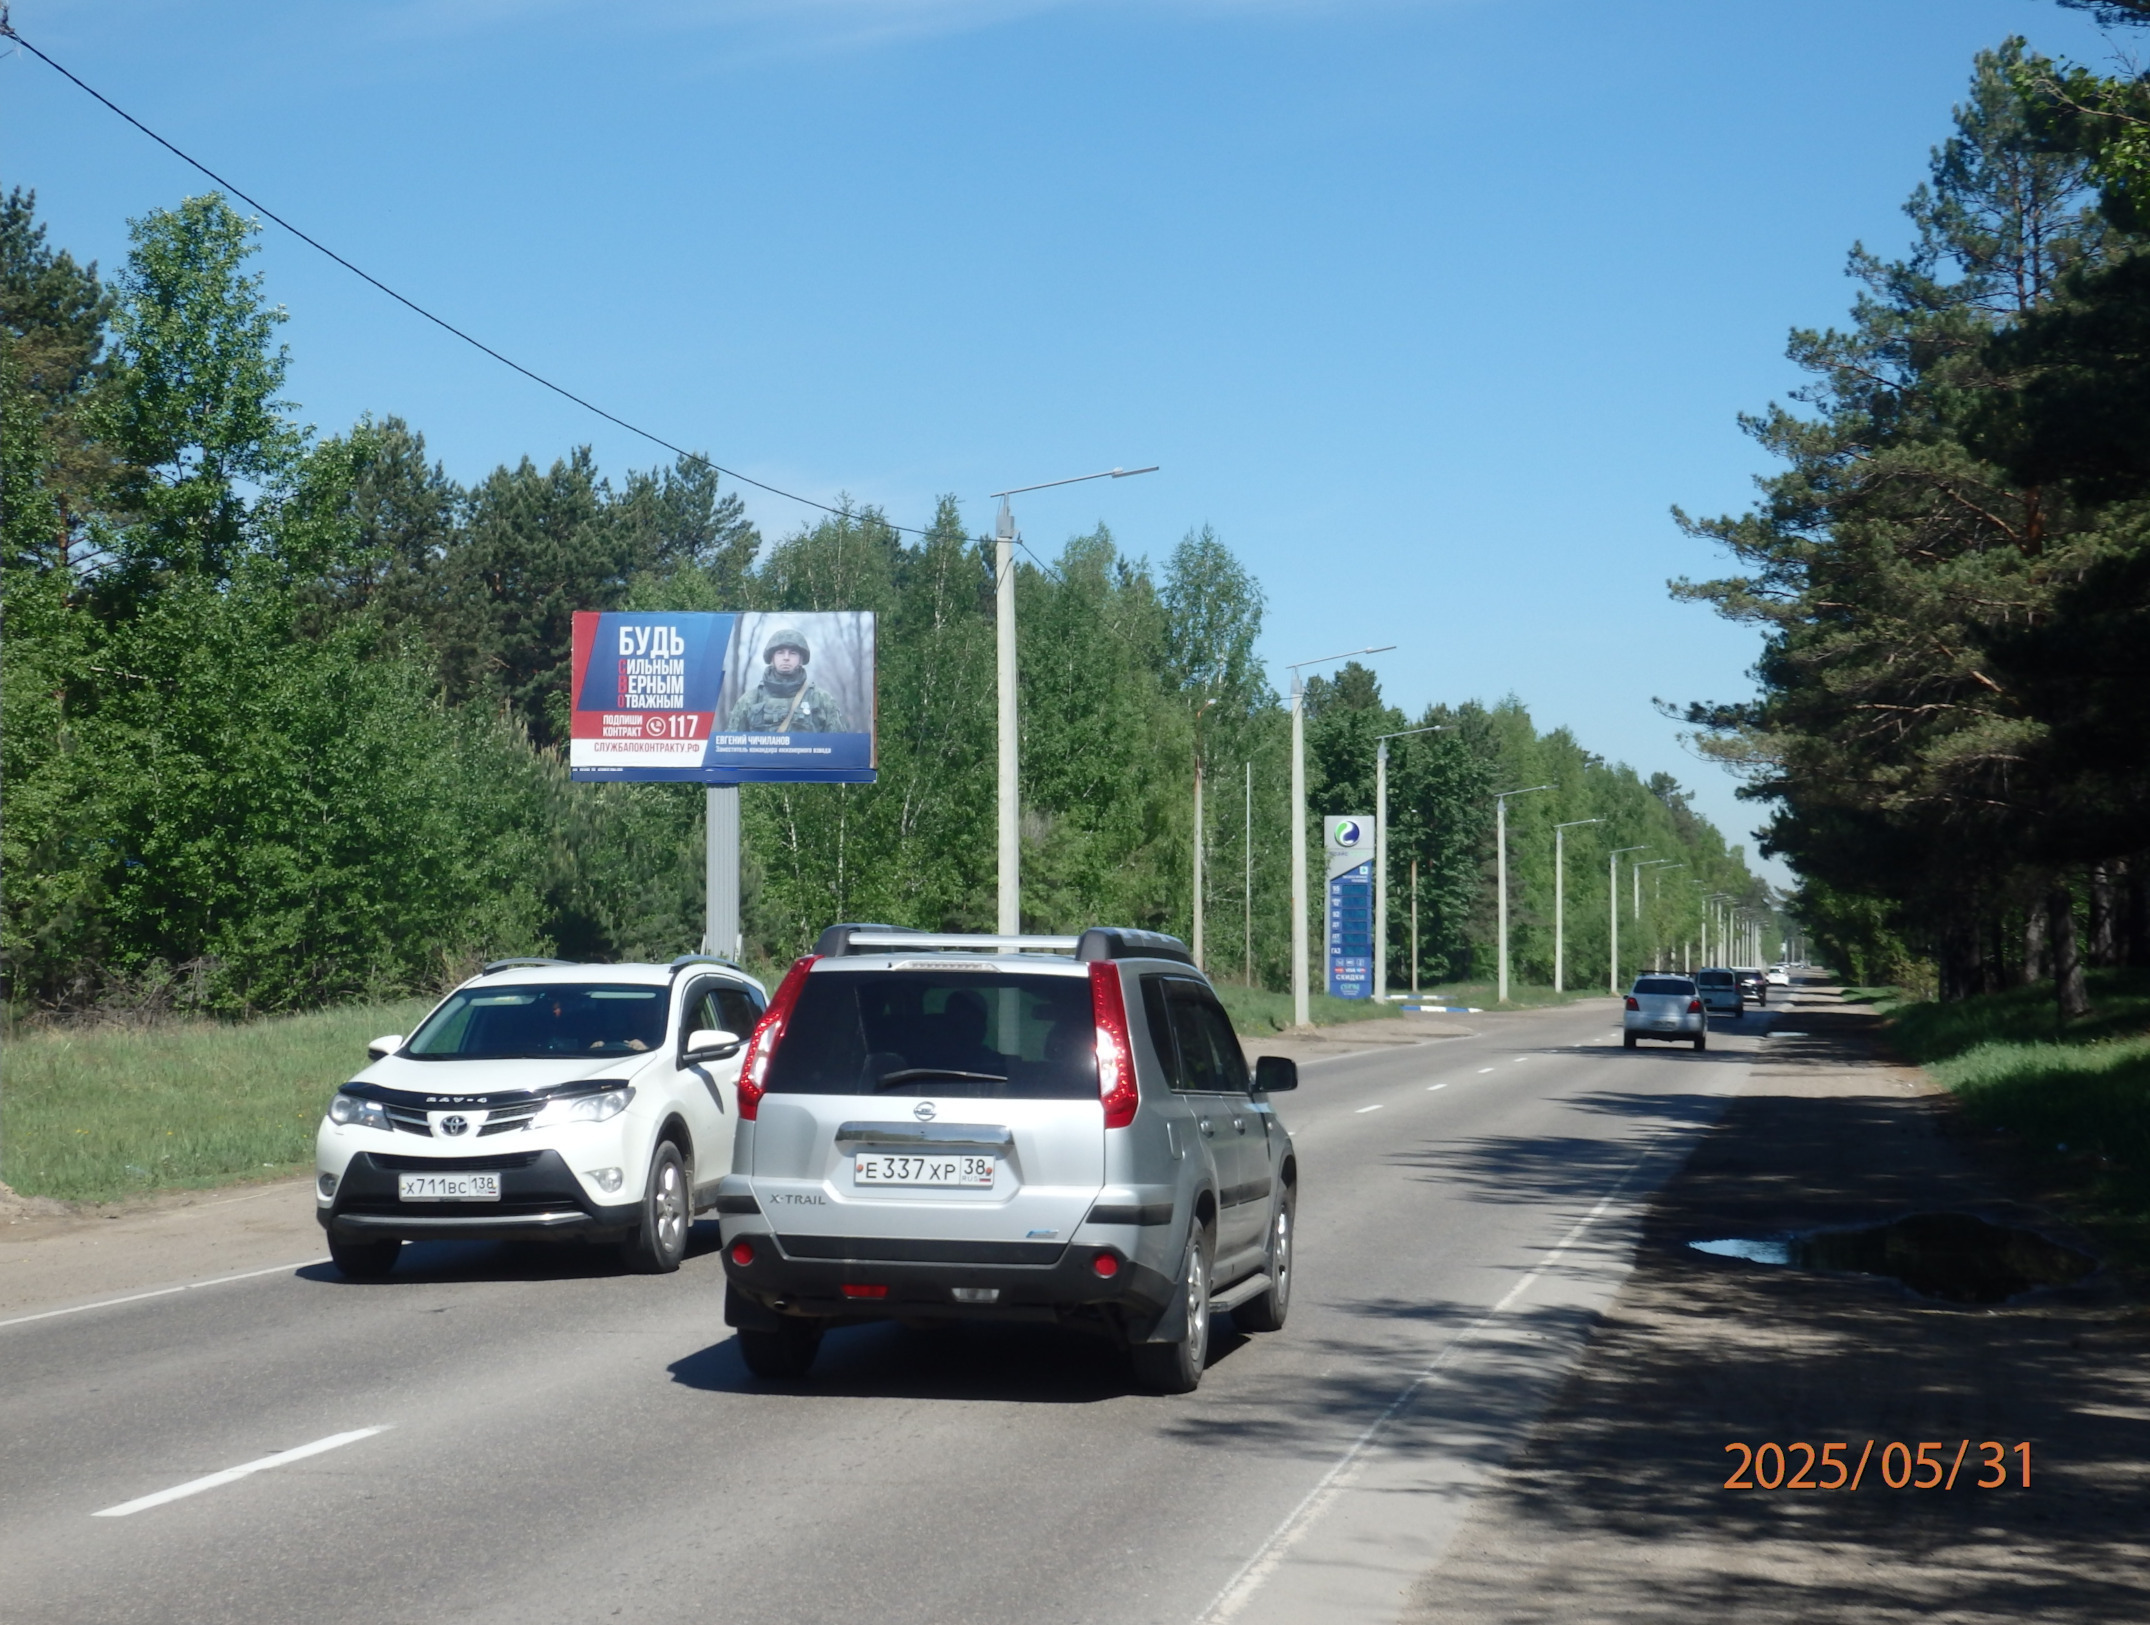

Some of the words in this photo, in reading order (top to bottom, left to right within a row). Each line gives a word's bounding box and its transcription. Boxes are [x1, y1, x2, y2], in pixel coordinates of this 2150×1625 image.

[619, 626, 685, 659] БУДЬ
[618, 659, 684, 675] СИЛЬНЫМ
[618, 675, 684, 694] ВЕРНЫМ
[617, 694, 684, 709] ОТВАЖНЫМ
[602, 715, 643, 726] ПОДПИШИ
[668, 715, 699, 738] 117
[602, 727, 642, 737] КОНТРАКТ
[715, 734, 747, 745] ЕВГЕНИЙ
[594, 742, 700, 753] СЛУЖБАПОКОНТРАКТУ.РФ
[964, 1158, 985, 1175] 38
[770, 1194, 826, 1205] X-TRAIL
